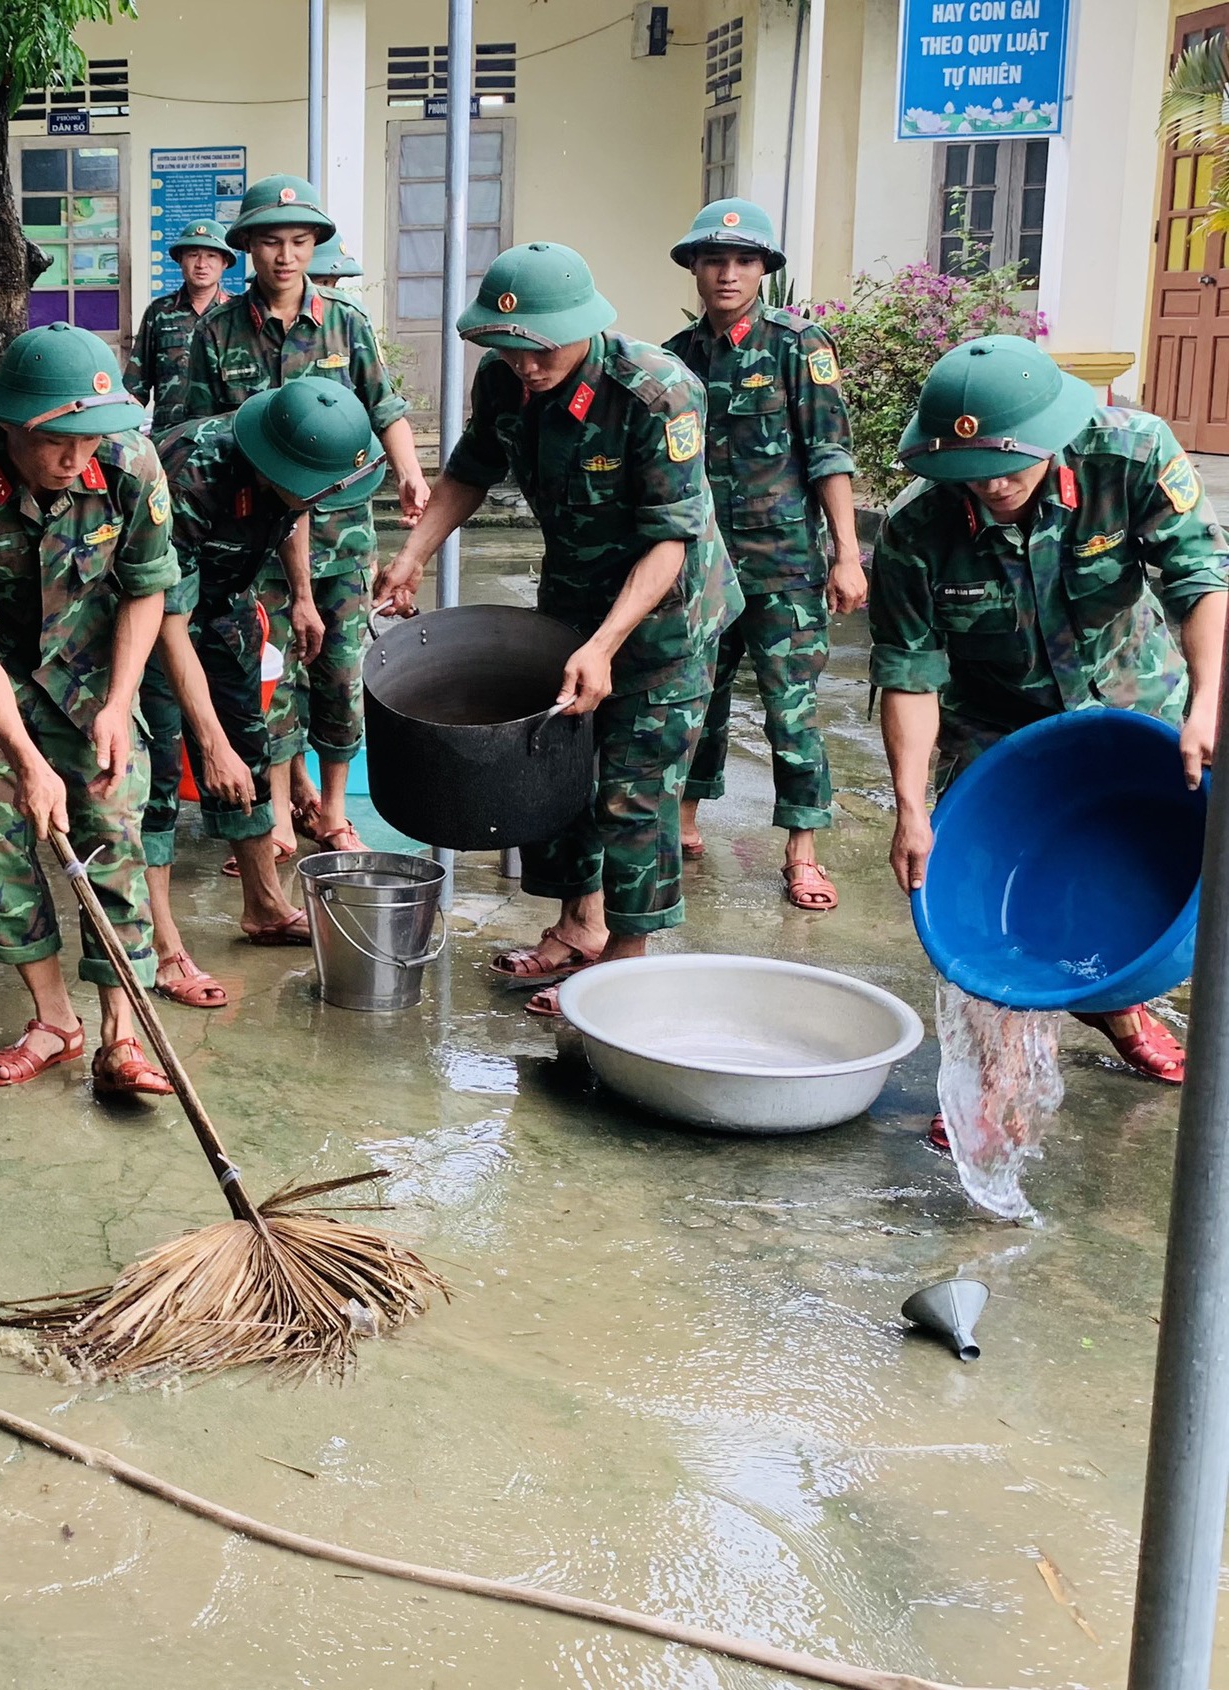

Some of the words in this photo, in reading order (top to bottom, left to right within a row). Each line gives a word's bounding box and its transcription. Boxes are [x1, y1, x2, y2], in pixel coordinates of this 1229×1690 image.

[932, 3, 965, 23] HAY
[970, 1, 1006, 21] CON
[921, 36, 963, 56] THEO
[968, 34, 1002, 56] QUY
[1006, 28, 1049, 55] LUẬT
[943, 66, 966, 90] TỰ
[968, 62, 1022, 86] NHIÊN
[52, 123, 71, 131] DÂN
[73, 121, 85, 131] SỐ
